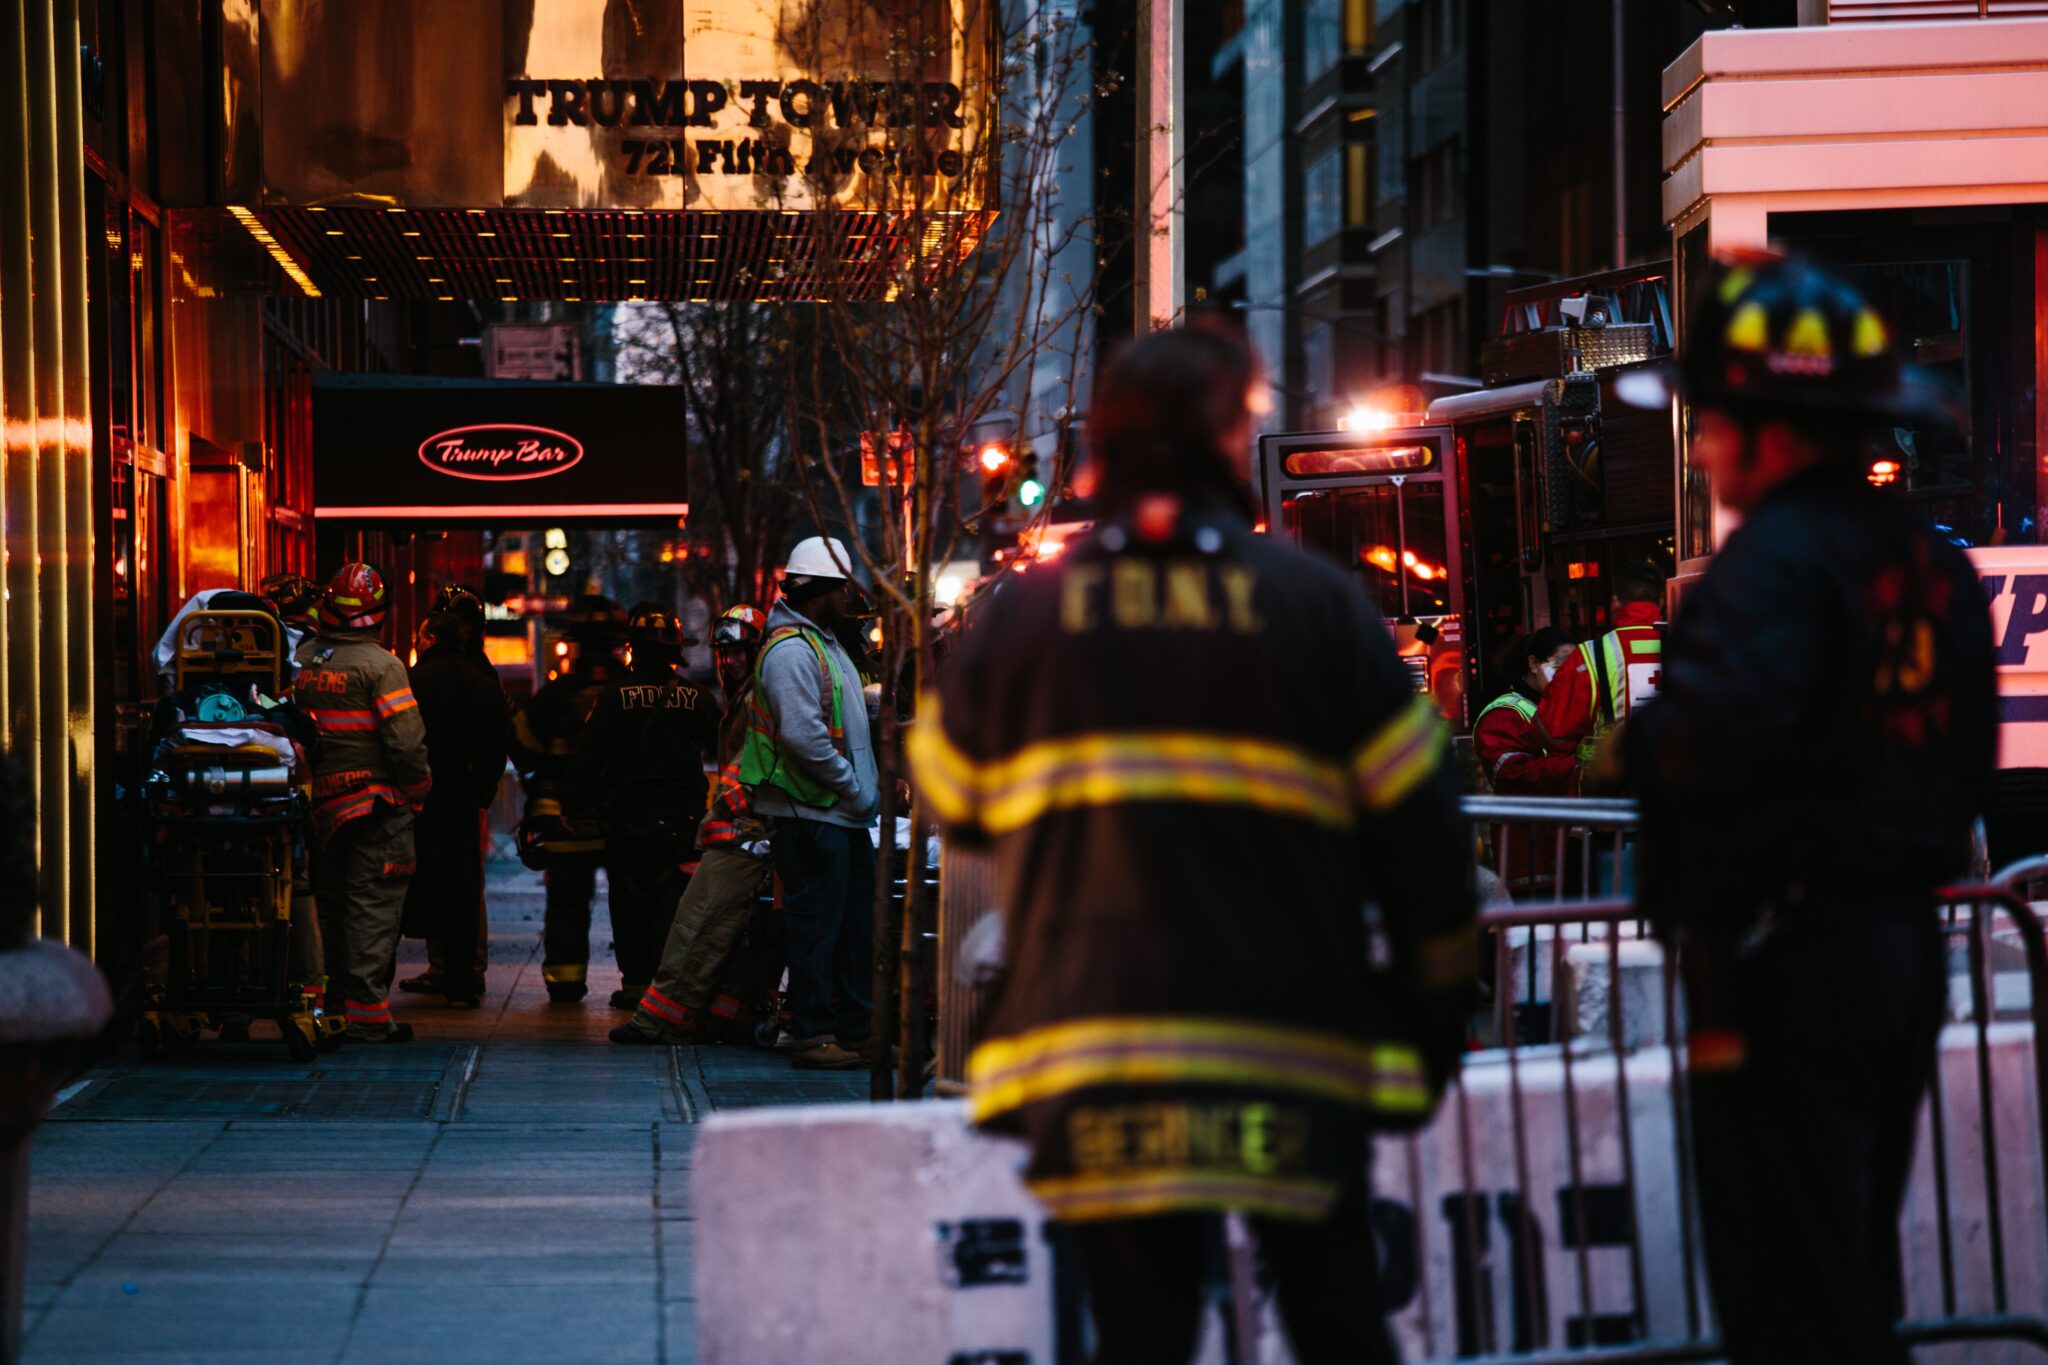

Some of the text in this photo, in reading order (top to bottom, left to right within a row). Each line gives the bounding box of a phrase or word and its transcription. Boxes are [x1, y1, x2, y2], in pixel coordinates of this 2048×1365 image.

[507, 79, 727, 127] TRUMP
[622, 140, 684, 175] 721
[696, 137, 795, 175] Fifth
[436, 438, 568, 468] Trump Bar
[1057, 557, 1265, 635] FDNY
[620, 684, 699, 711] FDNY
